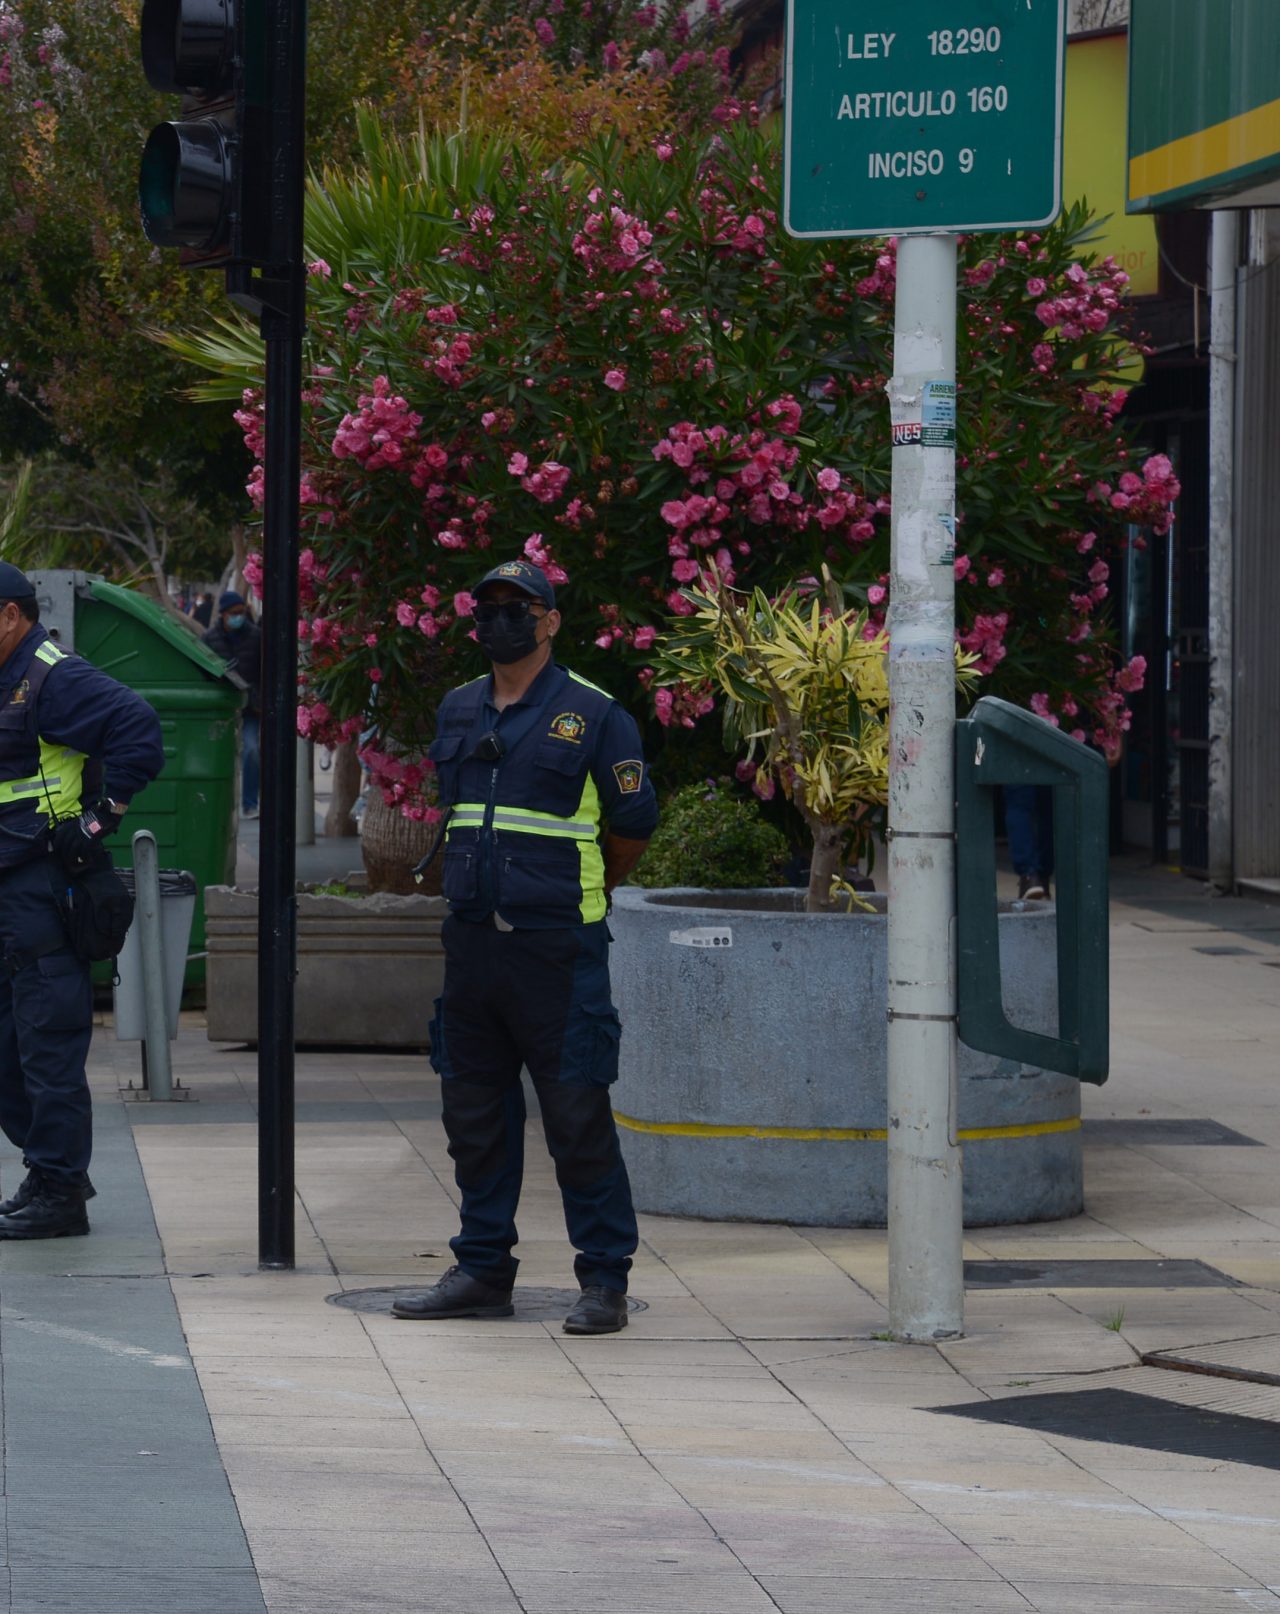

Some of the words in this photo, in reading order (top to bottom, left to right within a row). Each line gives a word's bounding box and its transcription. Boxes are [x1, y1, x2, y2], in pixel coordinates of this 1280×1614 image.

[847, 33, 896, 59] LEY
[837, 90, 956, 120] ARTICULO
[967, 85, 1008, 113] 160
[868, 149, 944, 178] INCISO
